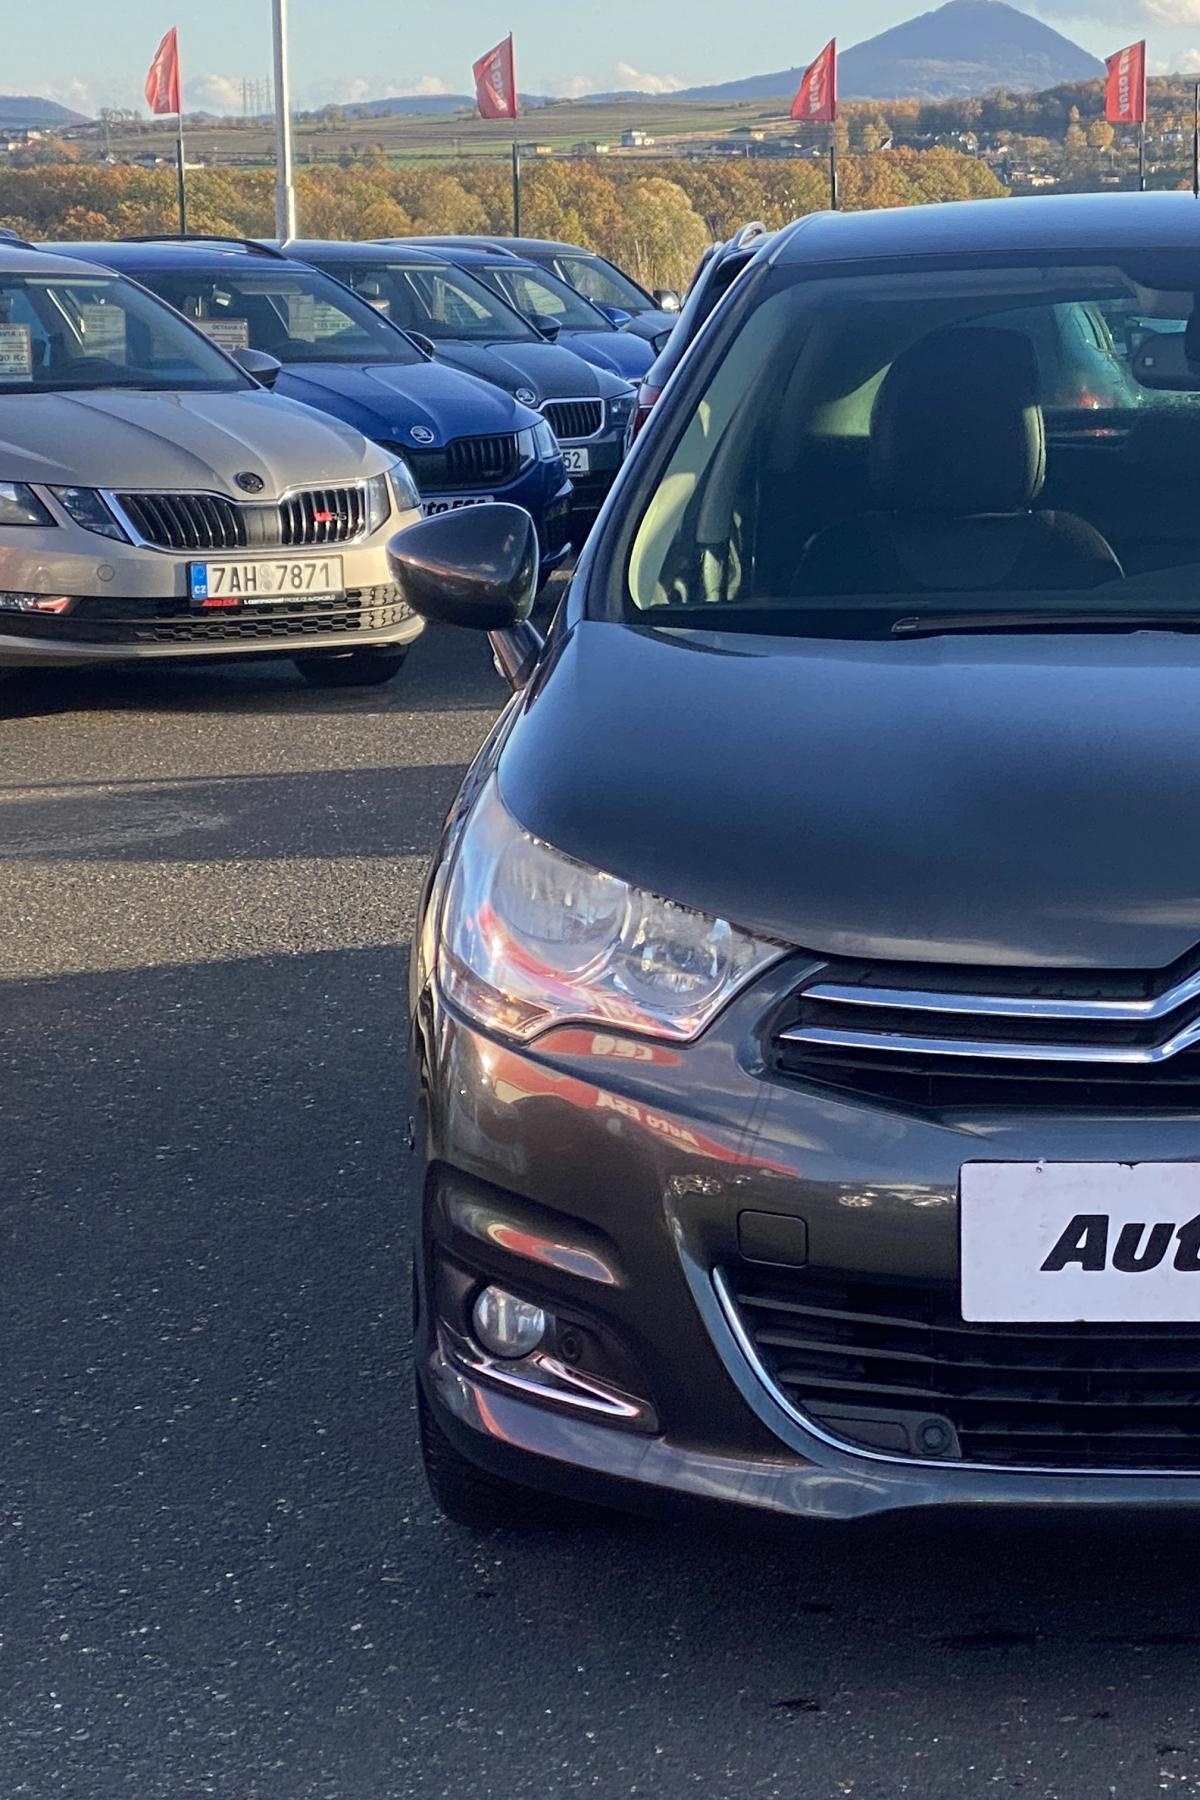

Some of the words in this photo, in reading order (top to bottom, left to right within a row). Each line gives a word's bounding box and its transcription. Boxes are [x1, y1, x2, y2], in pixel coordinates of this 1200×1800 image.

[563, 452, 581, 469] 52
[194, 585, 206, 594] CZ
[212, 566, 257, 593] 7AH
[275, 562, 330, 590] 7871
